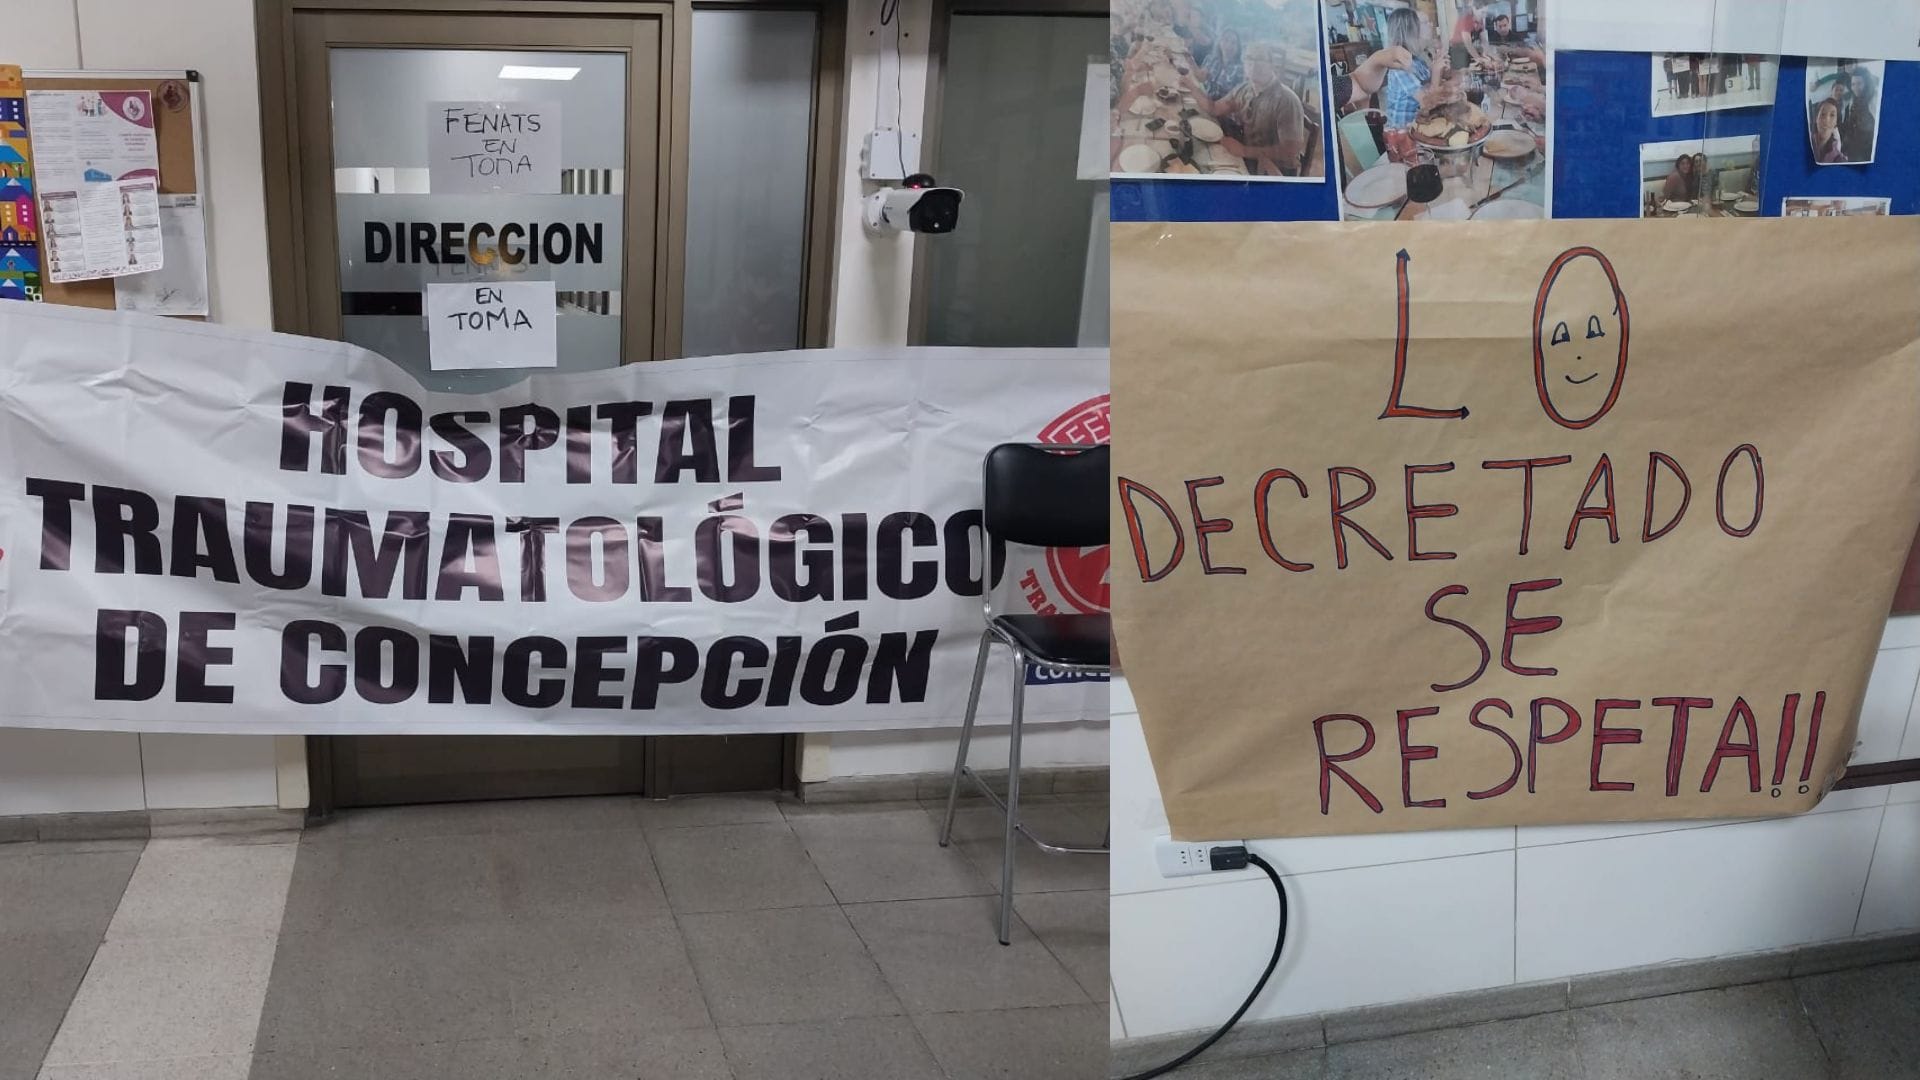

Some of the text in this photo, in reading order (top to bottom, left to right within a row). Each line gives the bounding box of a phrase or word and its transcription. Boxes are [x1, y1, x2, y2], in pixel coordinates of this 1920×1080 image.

[443, 108, 542, 134] FENATS
[482, 138, 518, 154] EN
[364, 221, 603, 265] DIRECCION
[447, 306, 533, 331] TOMA
[475, 286, 504, 305] EN
[1377, 246, 1630, 430] LO
[279, 380, 782, 484] HOSPITAL
[26, 477, 1006, 603] TRAUMATOLÓGICO
[1117, 443, 1765, 582] DECRETADO
[94, 607, 939, 710] DE CONCEPCIÓN
[1425, 578, 1563, 692] SE
[1312, 690, 1826, 816] RESPETA!!
